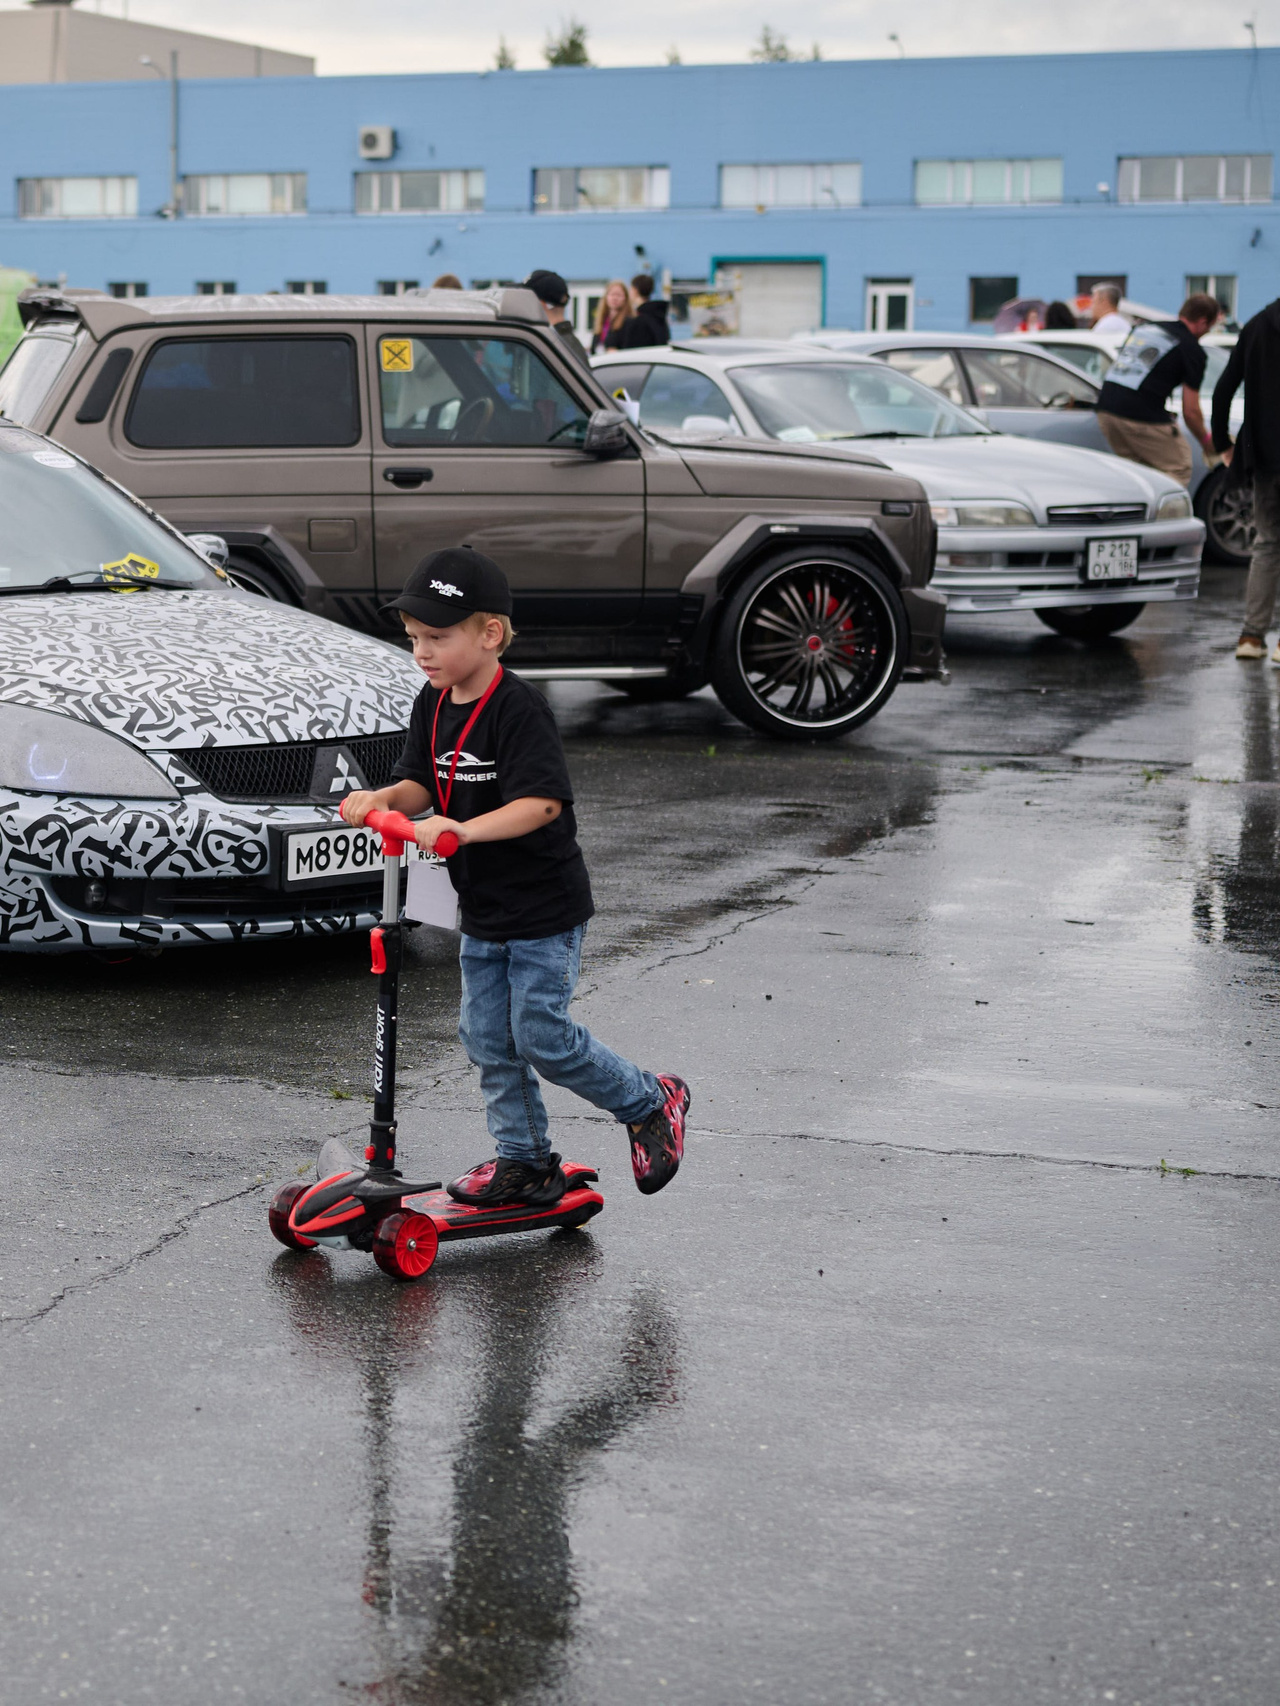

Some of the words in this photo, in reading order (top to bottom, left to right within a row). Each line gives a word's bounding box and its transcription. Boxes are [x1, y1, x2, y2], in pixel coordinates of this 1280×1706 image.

[1110, 543, 1131, 557] 212
[296, 832, 384, 875] M898M
[375, 1003, 386, 1052] SPORT
